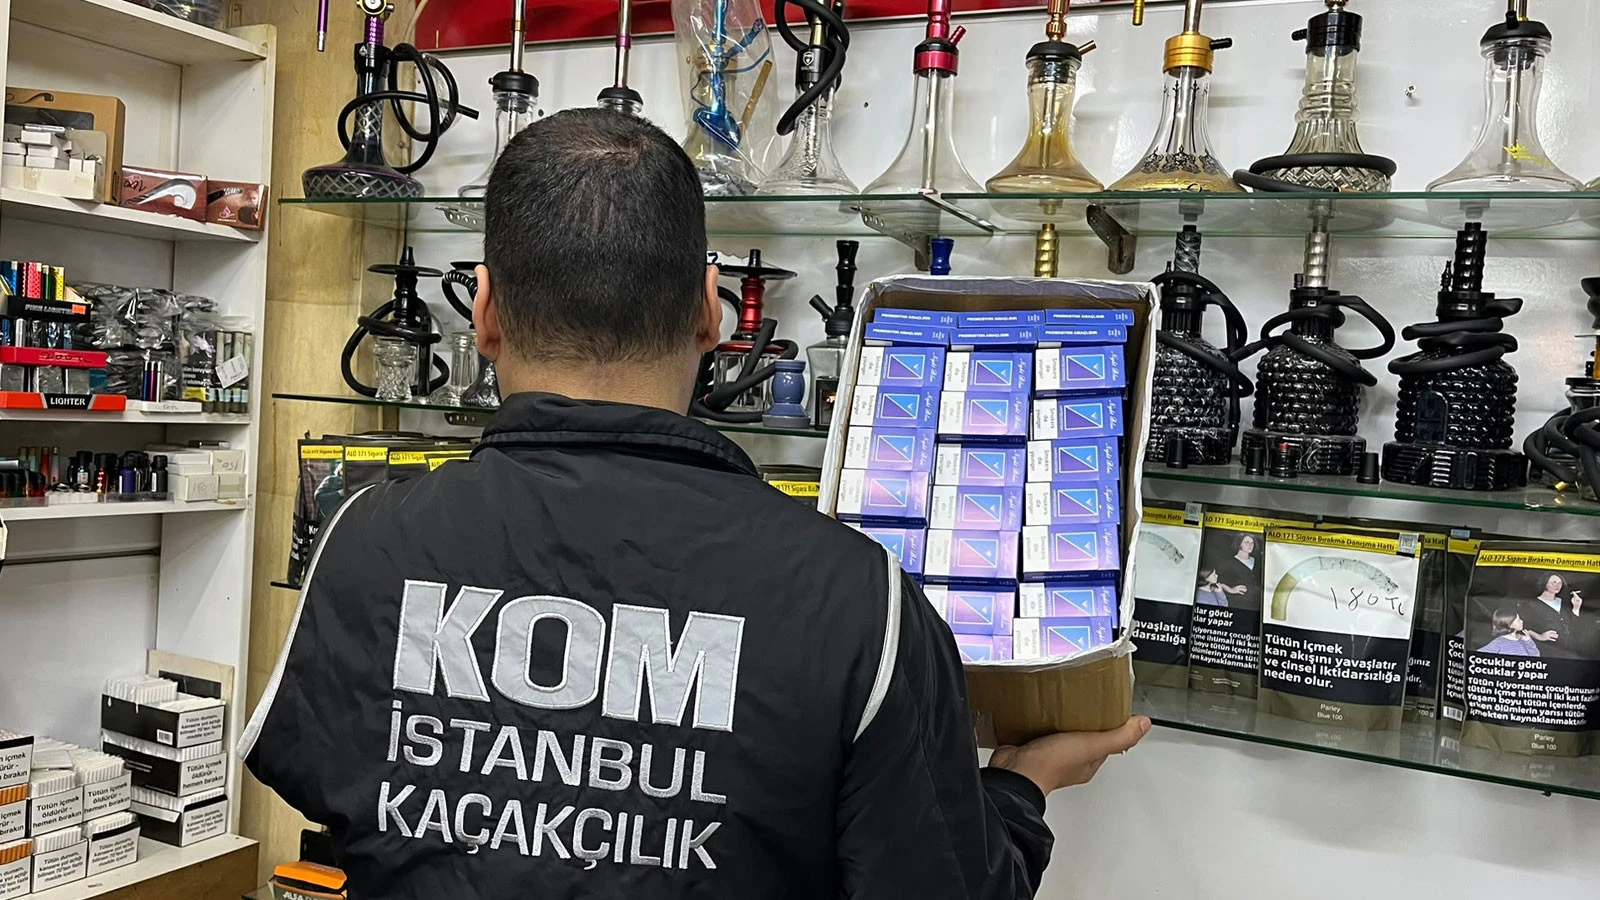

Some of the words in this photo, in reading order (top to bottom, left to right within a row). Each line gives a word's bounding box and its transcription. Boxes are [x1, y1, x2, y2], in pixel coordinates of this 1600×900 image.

[50, 397, 86, 406] LIGHTER
[1296, 533, 1316, 542] Sigara
[1318, 535, 1345, 544] Bırakma
[1330, 587, 1378, 611] 180
[1208, 609, 1233, 619] görür
[1134, 619, 1183, 634] avaşlatır
[1207, 618, 1233, 627] yapar
[1132, 630, 1186, 645] darsızlığa
[1207, 634, 1234, 644] ihtimali
[1229, 632, 1260, 641] çocuğun
[1210, 642, 1230, 651] tütün
[1265, 634, 1300, 648] Tütün
[1303, 640, 1343, 655] içmek
[393, 579, 745, 733] KOM
[1222, 652, 1243, 660] yarısı
[1265, 645, 1287, 657] kan
[1290, 649, 1331, 665] akışını
[1335, 655, 1397, 670] yavaşlatır
[1408, 657, 1431, 666] ğınız
[1468, 655, 1515, 668] Çocuklar
[1518, 661, 1547, 670] görür
[1264, 658, 1278, 666] ve
[1280, 659, 1316, 674] cinsel
[1319, 665, 1401, 684] iktidarsızlığa
[1264, 668, 1301, 682] neden
[1304, 675, 1333, 688] olur.
[1468, 665, 1516, 677] Çocuklar
[1517, 670, 1548, 680] yapar
[1468, 676, 1494, 686] Tütün
[1496, 680, 1543, 692] içiyorsanız
[1467, 685, 1492, 695] tütün
[1494, 687, 1516, 698] içme
[1518, 690, 1552, 700] ihtimali
[1554, 693, 1565, 701] iki
[1566, 693, 1579, 702] kat
[1467, 692, 1496, 703] Yaşam
[1499, 697, 1522, 708] boyu
[1523, 700, 1547, 708] tütün
[1320, 703, 1341, 713] Parley
[1469, 701, 1492, 710] erken
[1494, 703, 1538, 715] ölümlerin
[1539, 708, 1563, 717] yarısı
[1565, 710, 1585, 718] tütün
[1534, 733, 1555, 742] Parley
[4, 753, 26, 762] içmek
[387, 700, 727, 804] İSTANBUL
[206, 760, 222, 769] içmek
[3, 770, 27, 780] bırakın
[183, 780, 203, 789] hemen
[204, 774, 223, 786] bırakın
[192, 769, 212, 780] öldürür
[87, 788, 108, 798] Tütün
[110, 782, 128, 793] içmek
[36, 803, 58, 812] Tütün
[60, 796, 79, 806] içmek
[84, 804, 108, 814] hemen
[108, 796, 130, 808] bırakın
[93, 793, 117, 804] öldürür
[1, 810, 22, 819] içmek
[33, 818, 57, 829] hemen
[58, 811, 82, 823] bırakın
[42, 808, 68, 818] öldürür
[0, 824, 24, 836] bırakın
[377, 781, 722, 870] KAÇAKÇILIK
